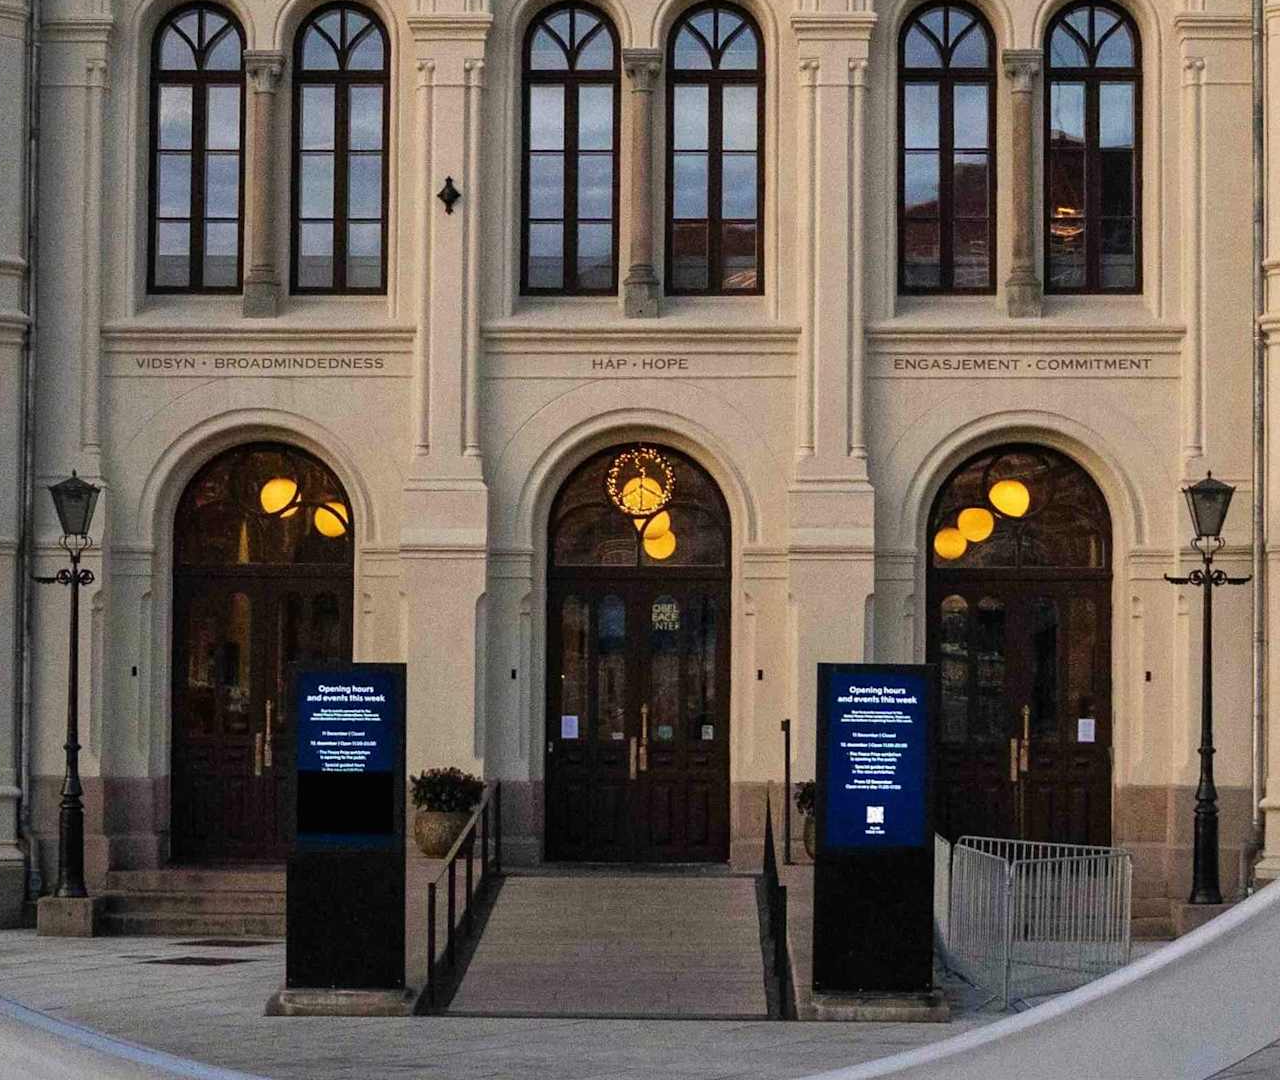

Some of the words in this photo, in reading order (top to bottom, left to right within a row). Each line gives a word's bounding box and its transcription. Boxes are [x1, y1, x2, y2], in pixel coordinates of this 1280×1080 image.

[135, 357, 197, 370] VIDSYN
[213, 357, 385, 370] BROADMINDEDNESS
[642, 358, 689, 370] HOPE
[893, 358, 1021, 371] ENGASJEMENT
[1035, 358, 1153, 371] COMMITMENT
[318, 685, 351, 694] Opening
[352, 685, 374, 693] hours
[849, 686, 883, 695] Opening
[883, 686, 906, 694] hours
[895, 696, 917, 704] week
